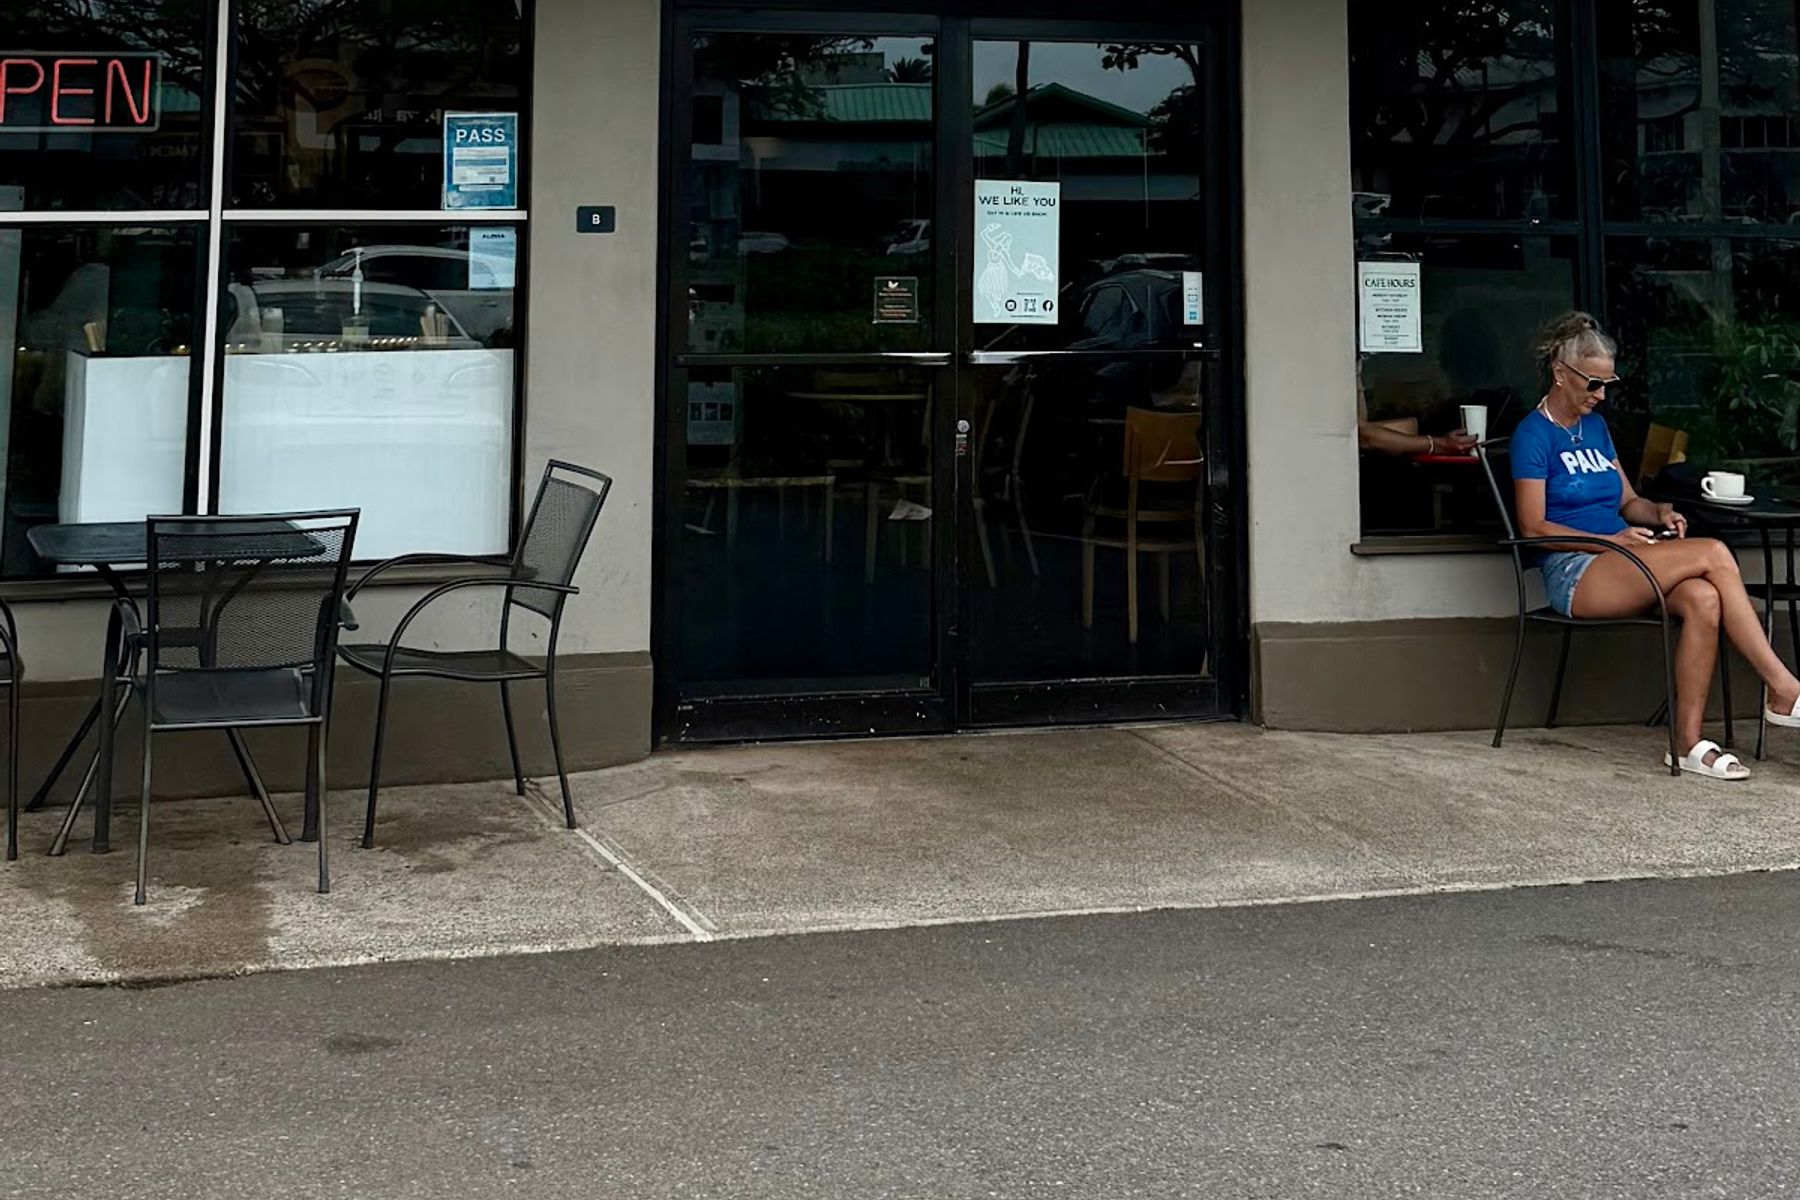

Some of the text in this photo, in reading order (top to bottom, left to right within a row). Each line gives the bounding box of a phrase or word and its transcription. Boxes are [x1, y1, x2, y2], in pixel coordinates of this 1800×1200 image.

[456, 128, 505, 143] PASS
[979, 195, 1056, 206] WE LIKE YOU
[592, 214, 600, 225] B
[1387, 279, 1415, 288] HOURS
